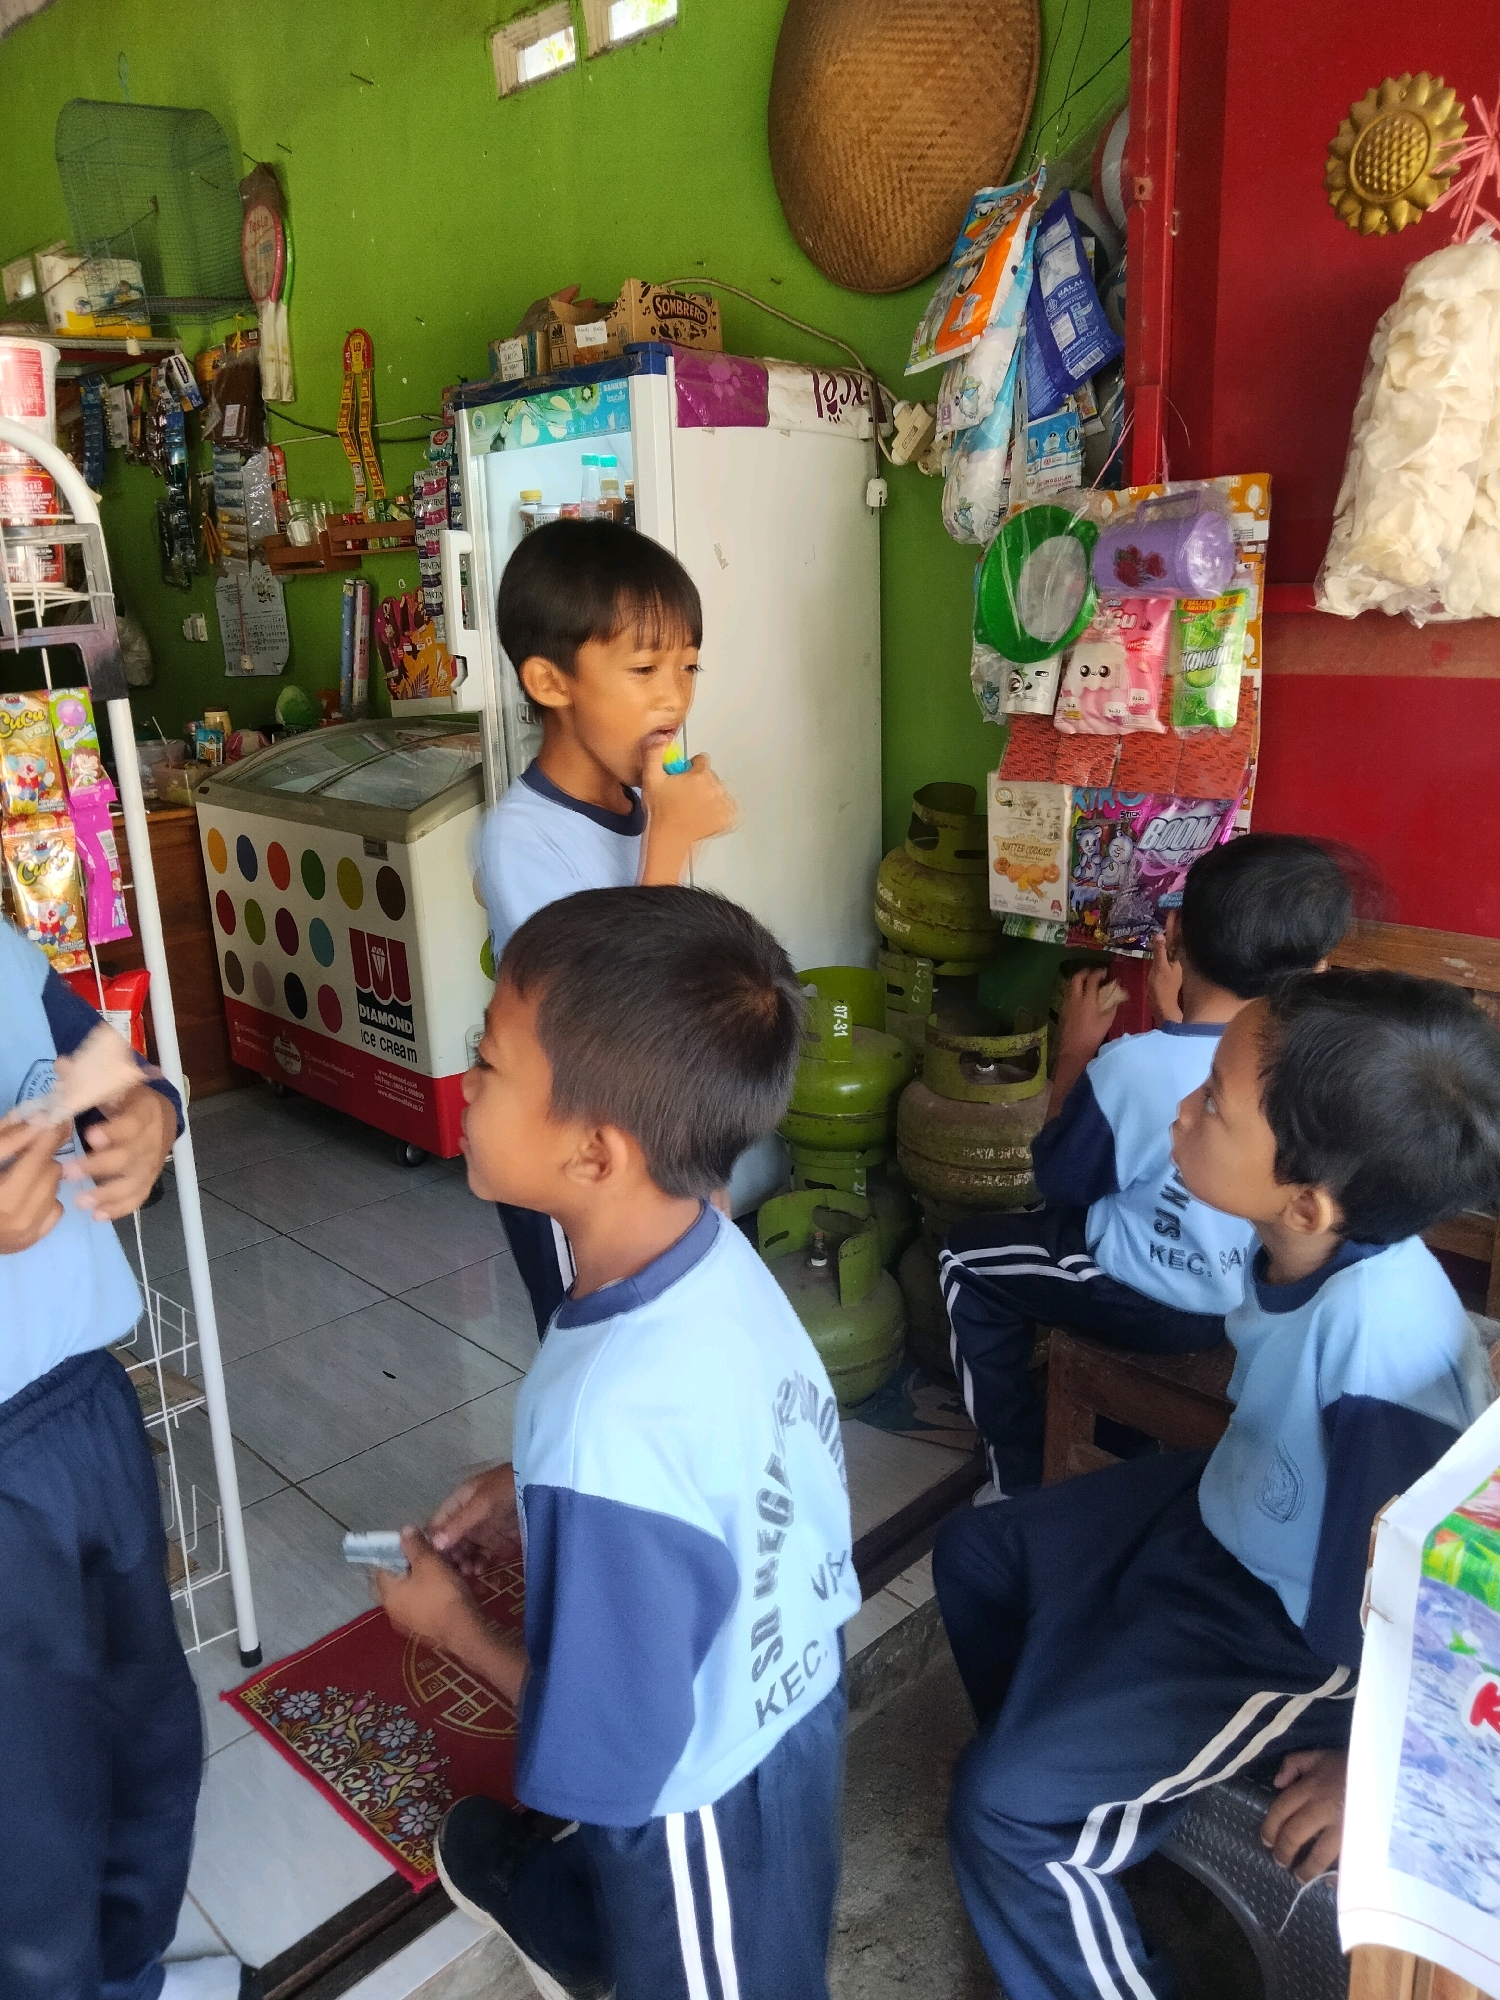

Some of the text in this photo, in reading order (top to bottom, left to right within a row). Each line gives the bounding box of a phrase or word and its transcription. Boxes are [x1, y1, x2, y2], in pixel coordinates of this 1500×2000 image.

[1057, 279, 1085, 297] HALAL
[655, 296, 707, 322] SOMBRERO
[603, 380, 627, 392] SANKEN
[1137, 816, 1218, 852] BOOM
[359, 1003, 412, 1034] DIAMOND
[833, 1005, 848, 1038] 07-31
[1149, 1239, 1213, 1278] KEC.
[754, 1638, 828, 1729] KEC.
